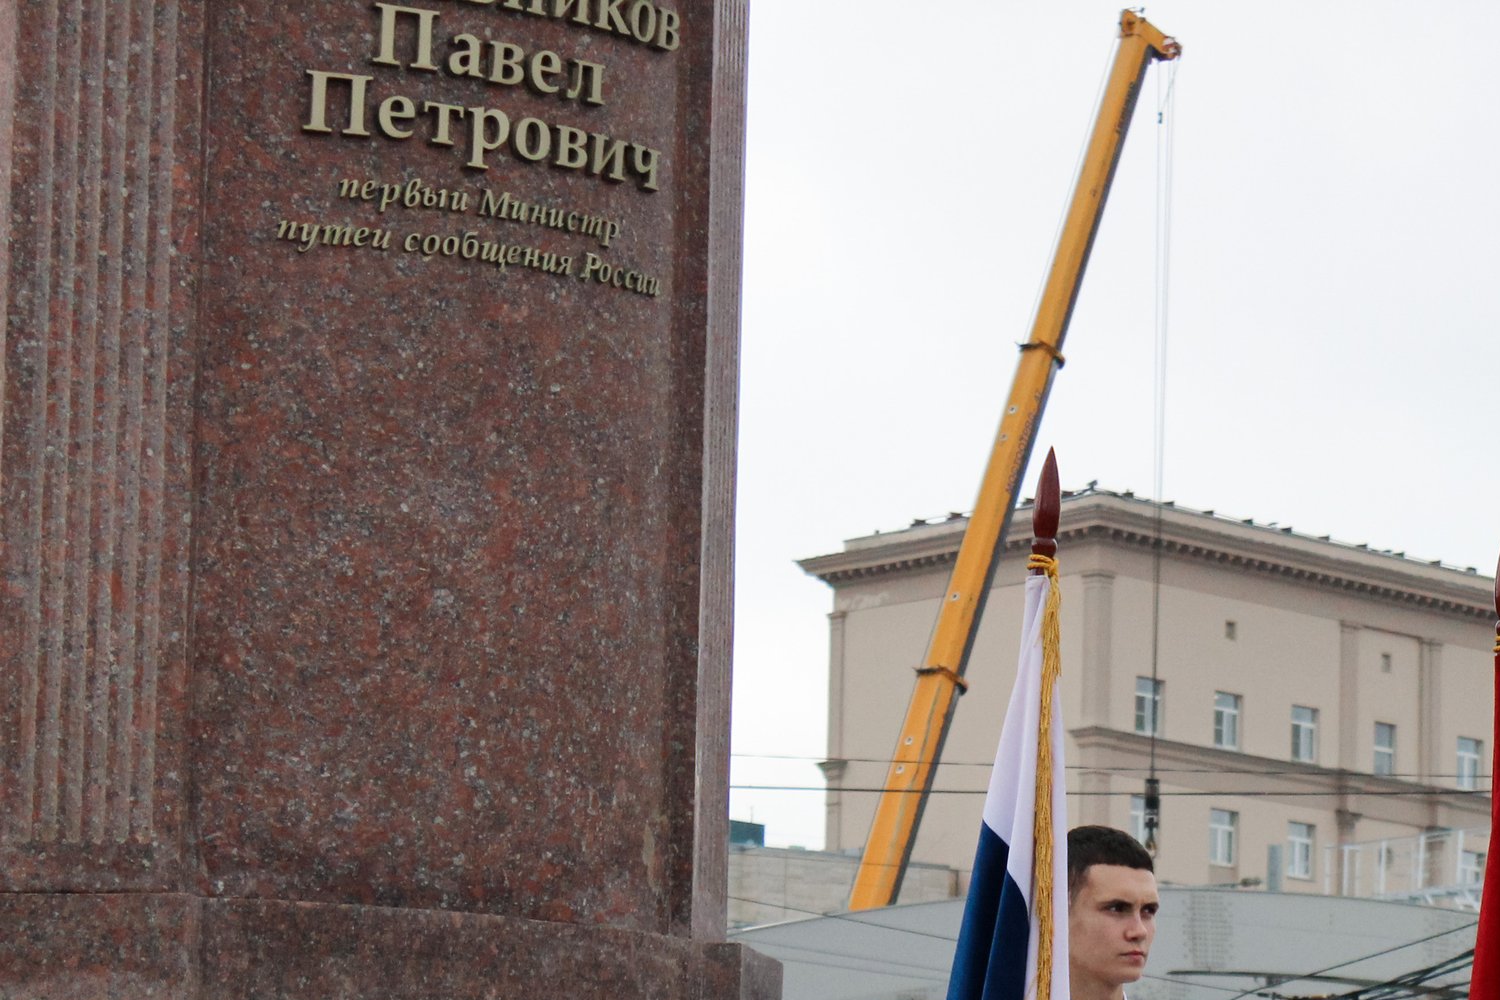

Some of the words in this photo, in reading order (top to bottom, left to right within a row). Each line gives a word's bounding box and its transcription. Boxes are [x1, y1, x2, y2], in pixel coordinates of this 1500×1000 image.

[373, 2, 606, 106] Павел
[302, 69, 662, 192] Петрович
[479, 188, 620, 248] Министр
[404, 231, 573, 276] сообщения
[579, 252, 662, 297] России
